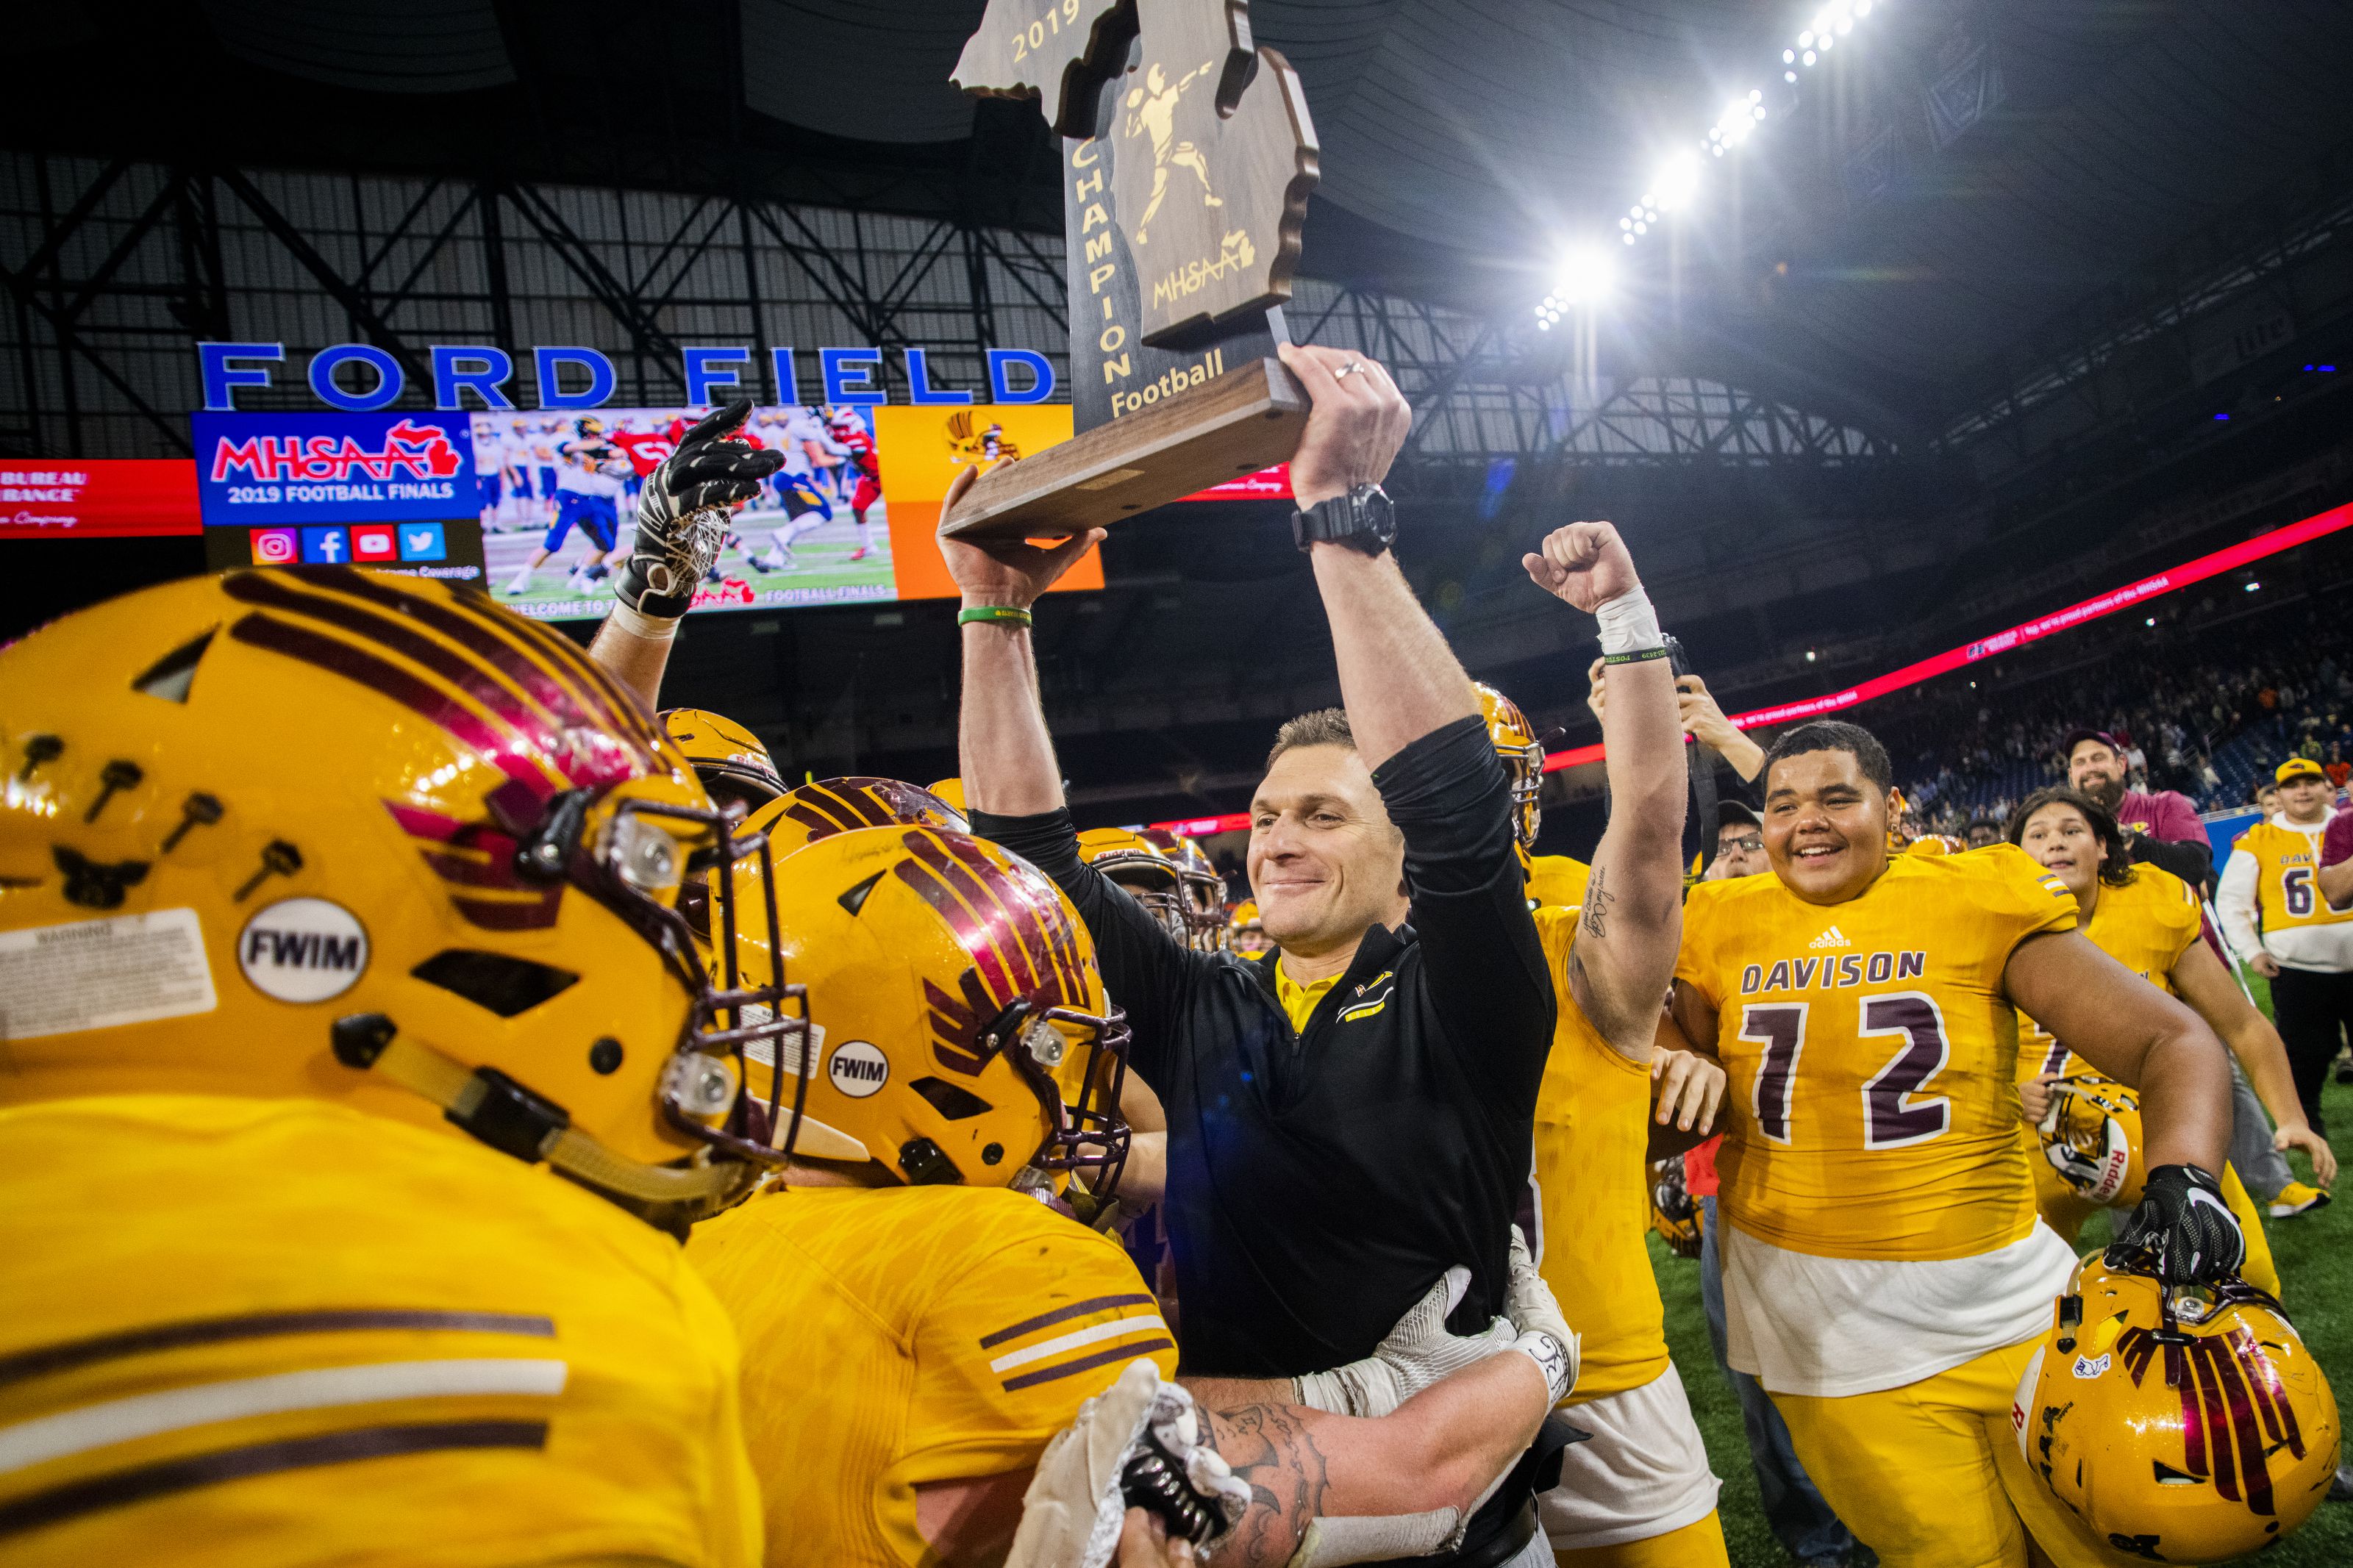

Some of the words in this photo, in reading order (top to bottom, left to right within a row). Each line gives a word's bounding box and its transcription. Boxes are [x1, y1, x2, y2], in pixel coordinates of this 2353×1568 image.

[1012, 0, 1079, 63] 2019
[1071, 137, 1131, 384] CHAMPION
[1153, 248, 1240, 309] MHSAA
[196, 341, 617, 410] FORD
[681, 346, 1057, 406] FIELD
[1110, 348, 1225, 418] Football
[210, 435, 431, 482] MHSAA
[227, 486, 282, 504] 2019
[285, 484, 384, 503] FOOTBALL
[387, 482, 455, 500] FINALS
[247, 928, 358, 971] FWIM
[1808, 938, 1852, 949] adidas
[1740, 951, 1927, 995] DAVISON
[832, 1056, 886, 1082] FWIM
